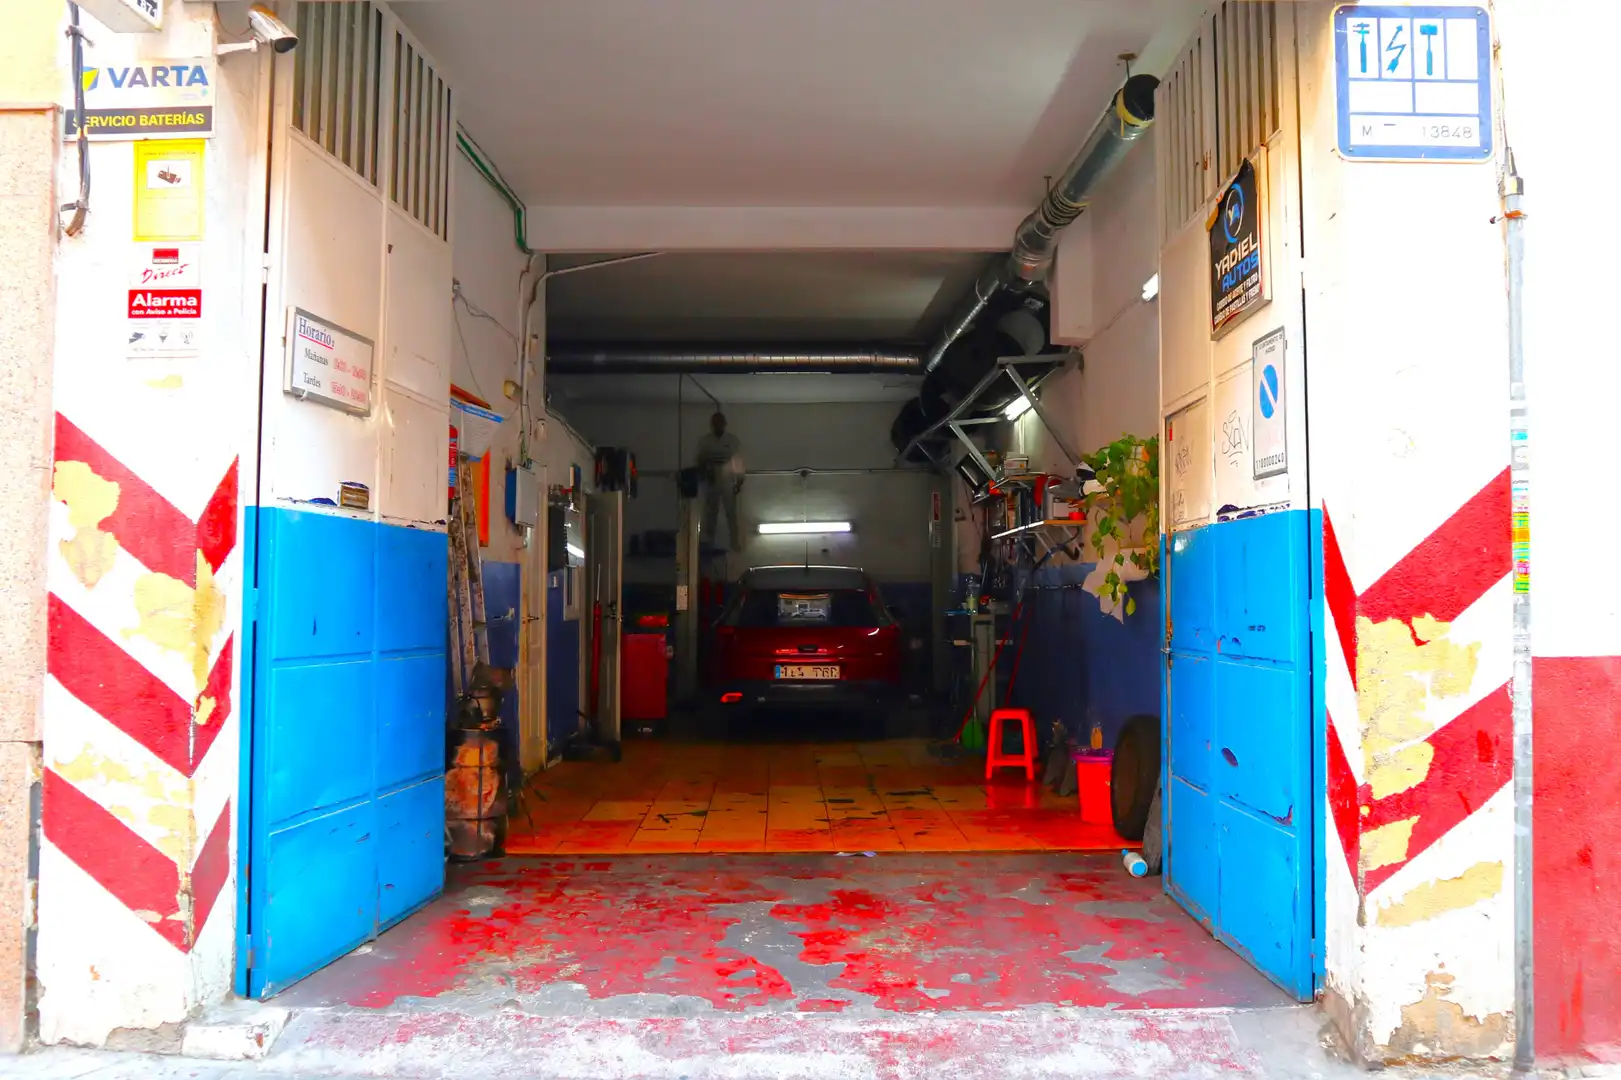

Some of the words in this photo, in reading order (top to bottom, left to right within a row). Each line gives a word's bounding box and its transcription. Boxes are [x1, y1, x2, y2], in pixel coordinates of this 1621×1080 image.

[107, 65, 209, 89] VARTA
[139, 111, 205, 126] BATERÍAS
[1362, 125, 1373, 137] M
[1422, 125, 1473, 139] 13848
[1215, 231, 1258, 281] YADIEL
[1222, 249, 1259, 293] AUTOS
[132, 292, 197, 307] Alarma
[299, 317, 335, 348] Horario:
[304, 347, 329, 366] Mañanas
[303, 372, 321, 388] Tardes
